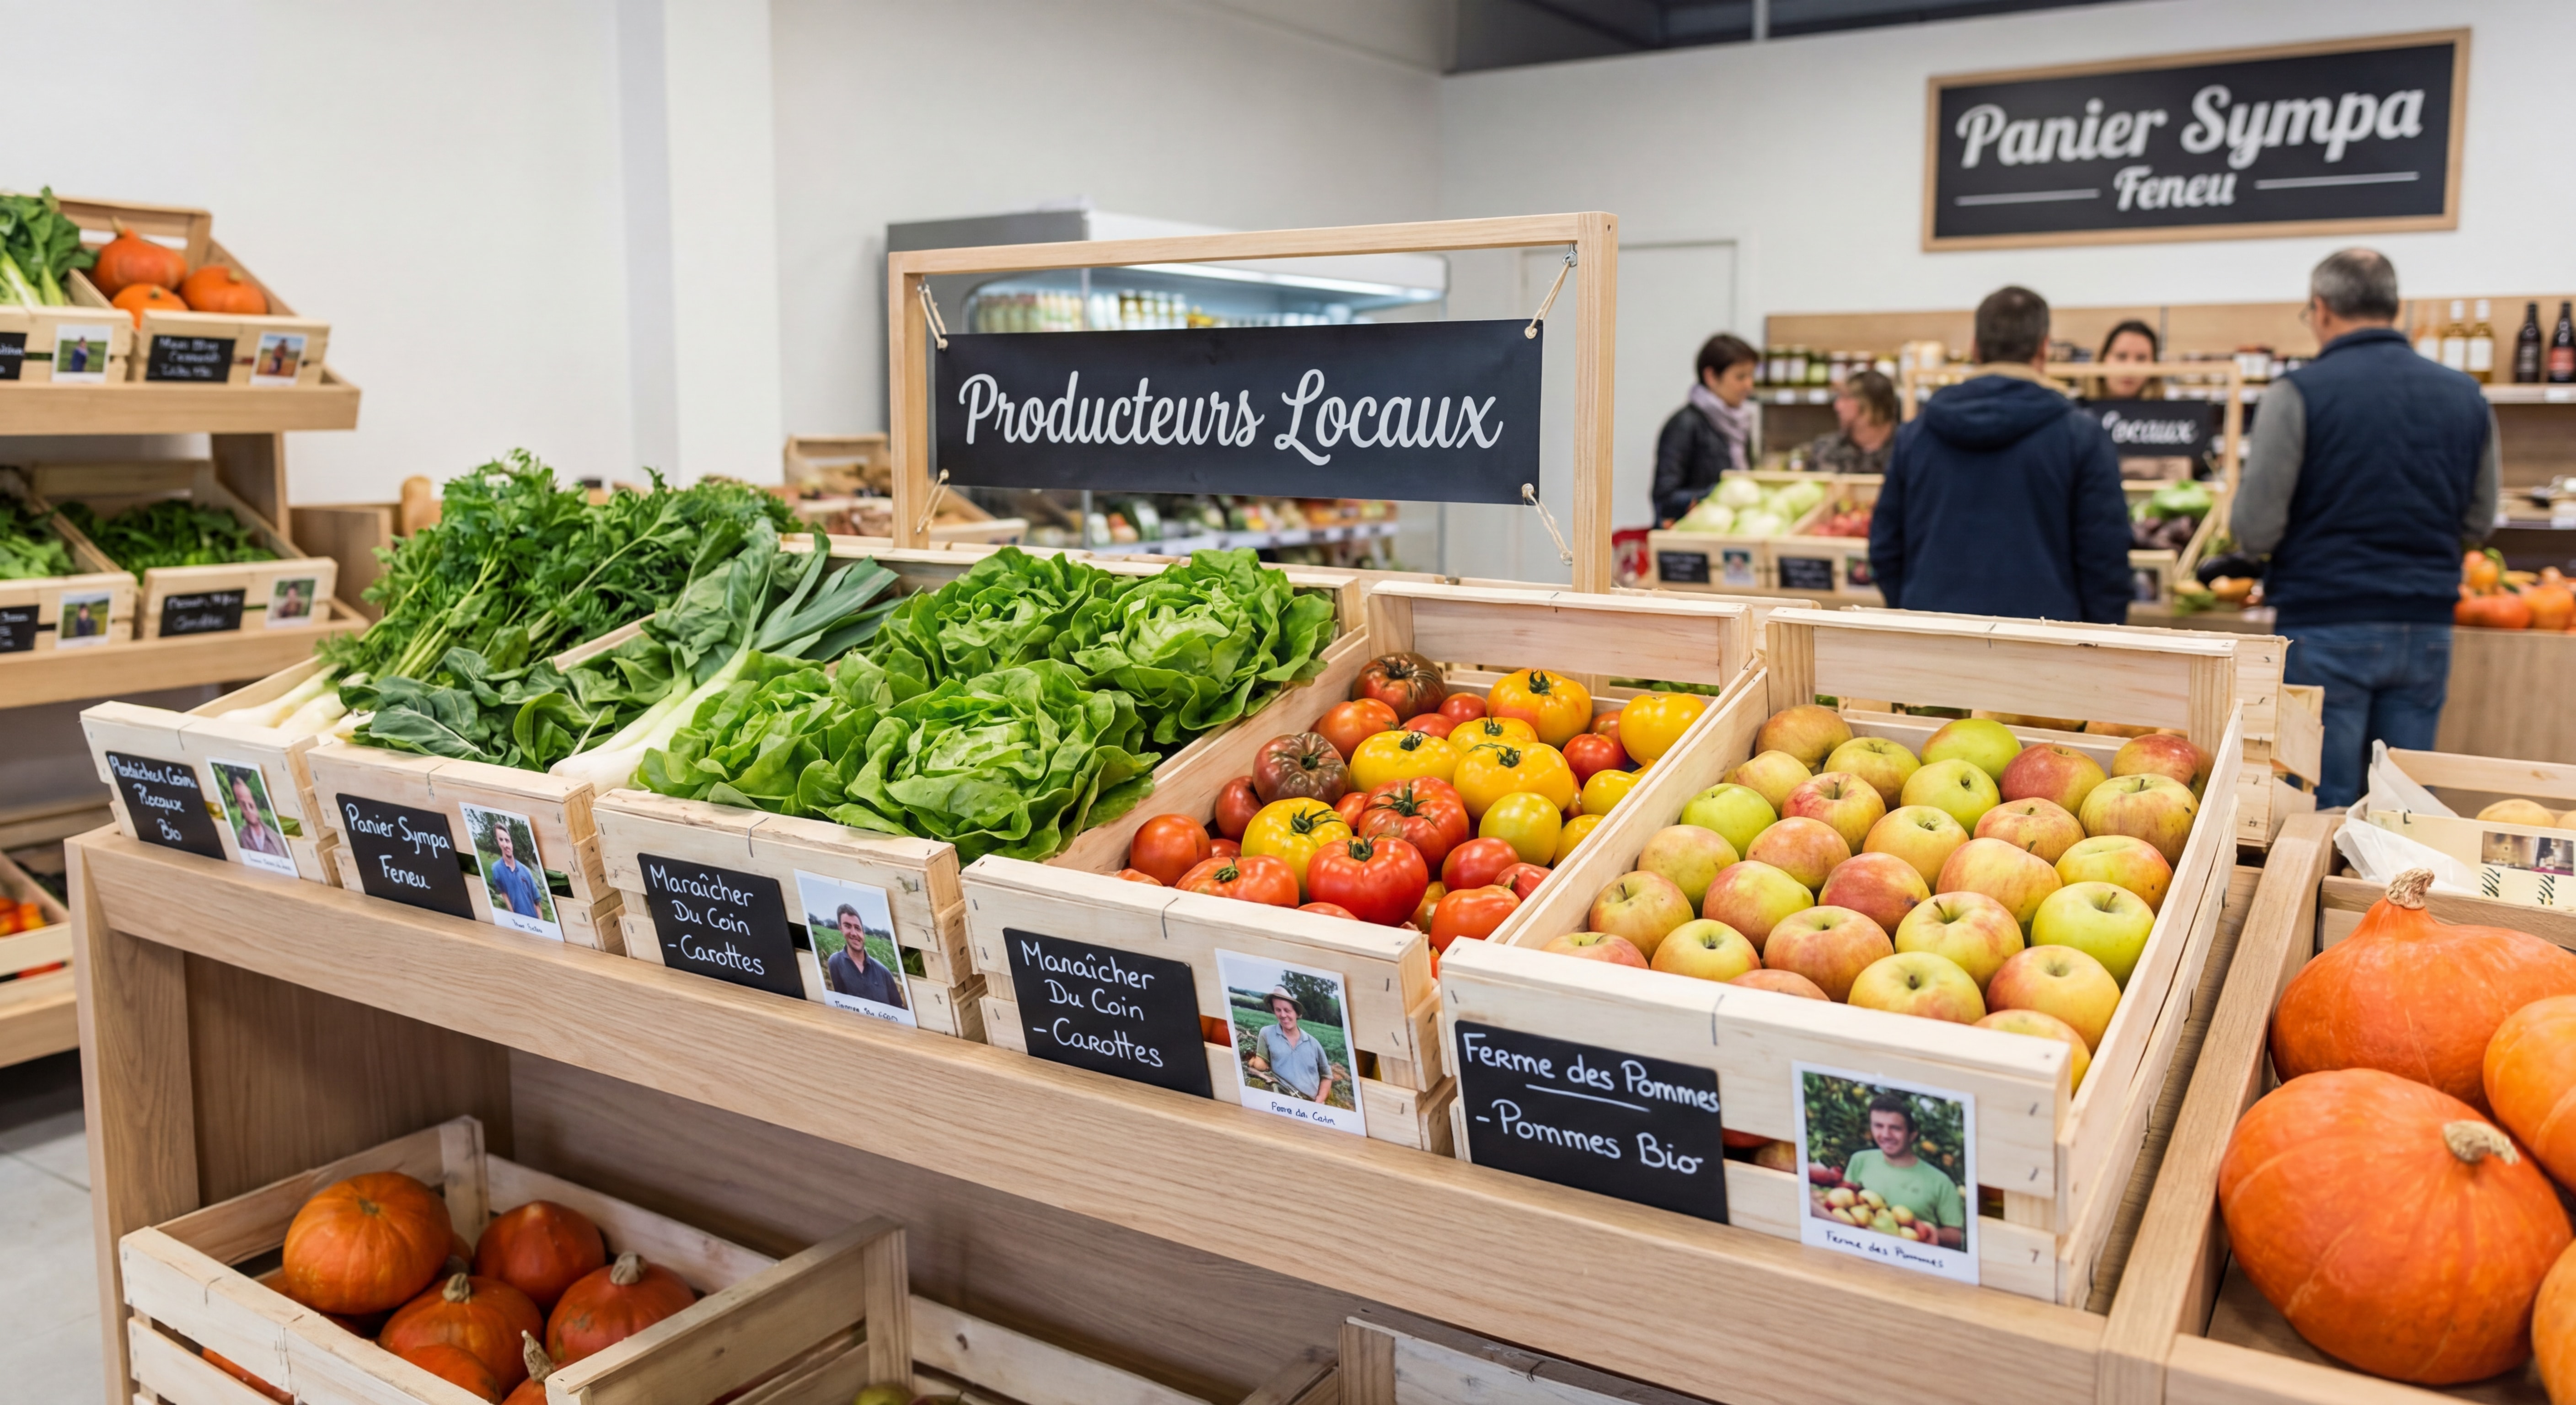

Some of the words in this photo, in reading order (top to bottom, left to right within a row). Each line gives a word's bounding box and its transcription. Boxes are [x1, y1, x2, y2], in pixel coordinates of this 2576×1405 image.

[1956, 98, 2168, 169] Panier
[2180, 86, 2424, 169] Sympa
[2114, 165, 2236, 211] Feneu
[959, 370, 1265, 447] Producteurs
[1274, 369, 1503, 466] Locaux
[157, 818, 182, 841] Bio
[343, 801, 396, 840] Panier
[398, 816, 450, 858] Sympa
[379, 853, 431, 890] Feneu
[649, 864, 753, 907] Maraîcher
[671, 900, 703, 925] Du
[707, 907, 751, 936] Coin
[1044, 979, 1084, 1008] Du
[1091, 988, 1144, 1021] Coin
[1567, 1054, 1614, 1091] des
[1621, 1060, 1720, 1113] Pommes
[1636, 1132, 1703, 1174] Bio
[1826, 1230, 1862, 1249] Ferme
[1869, 1242, 1888, 1255] des
